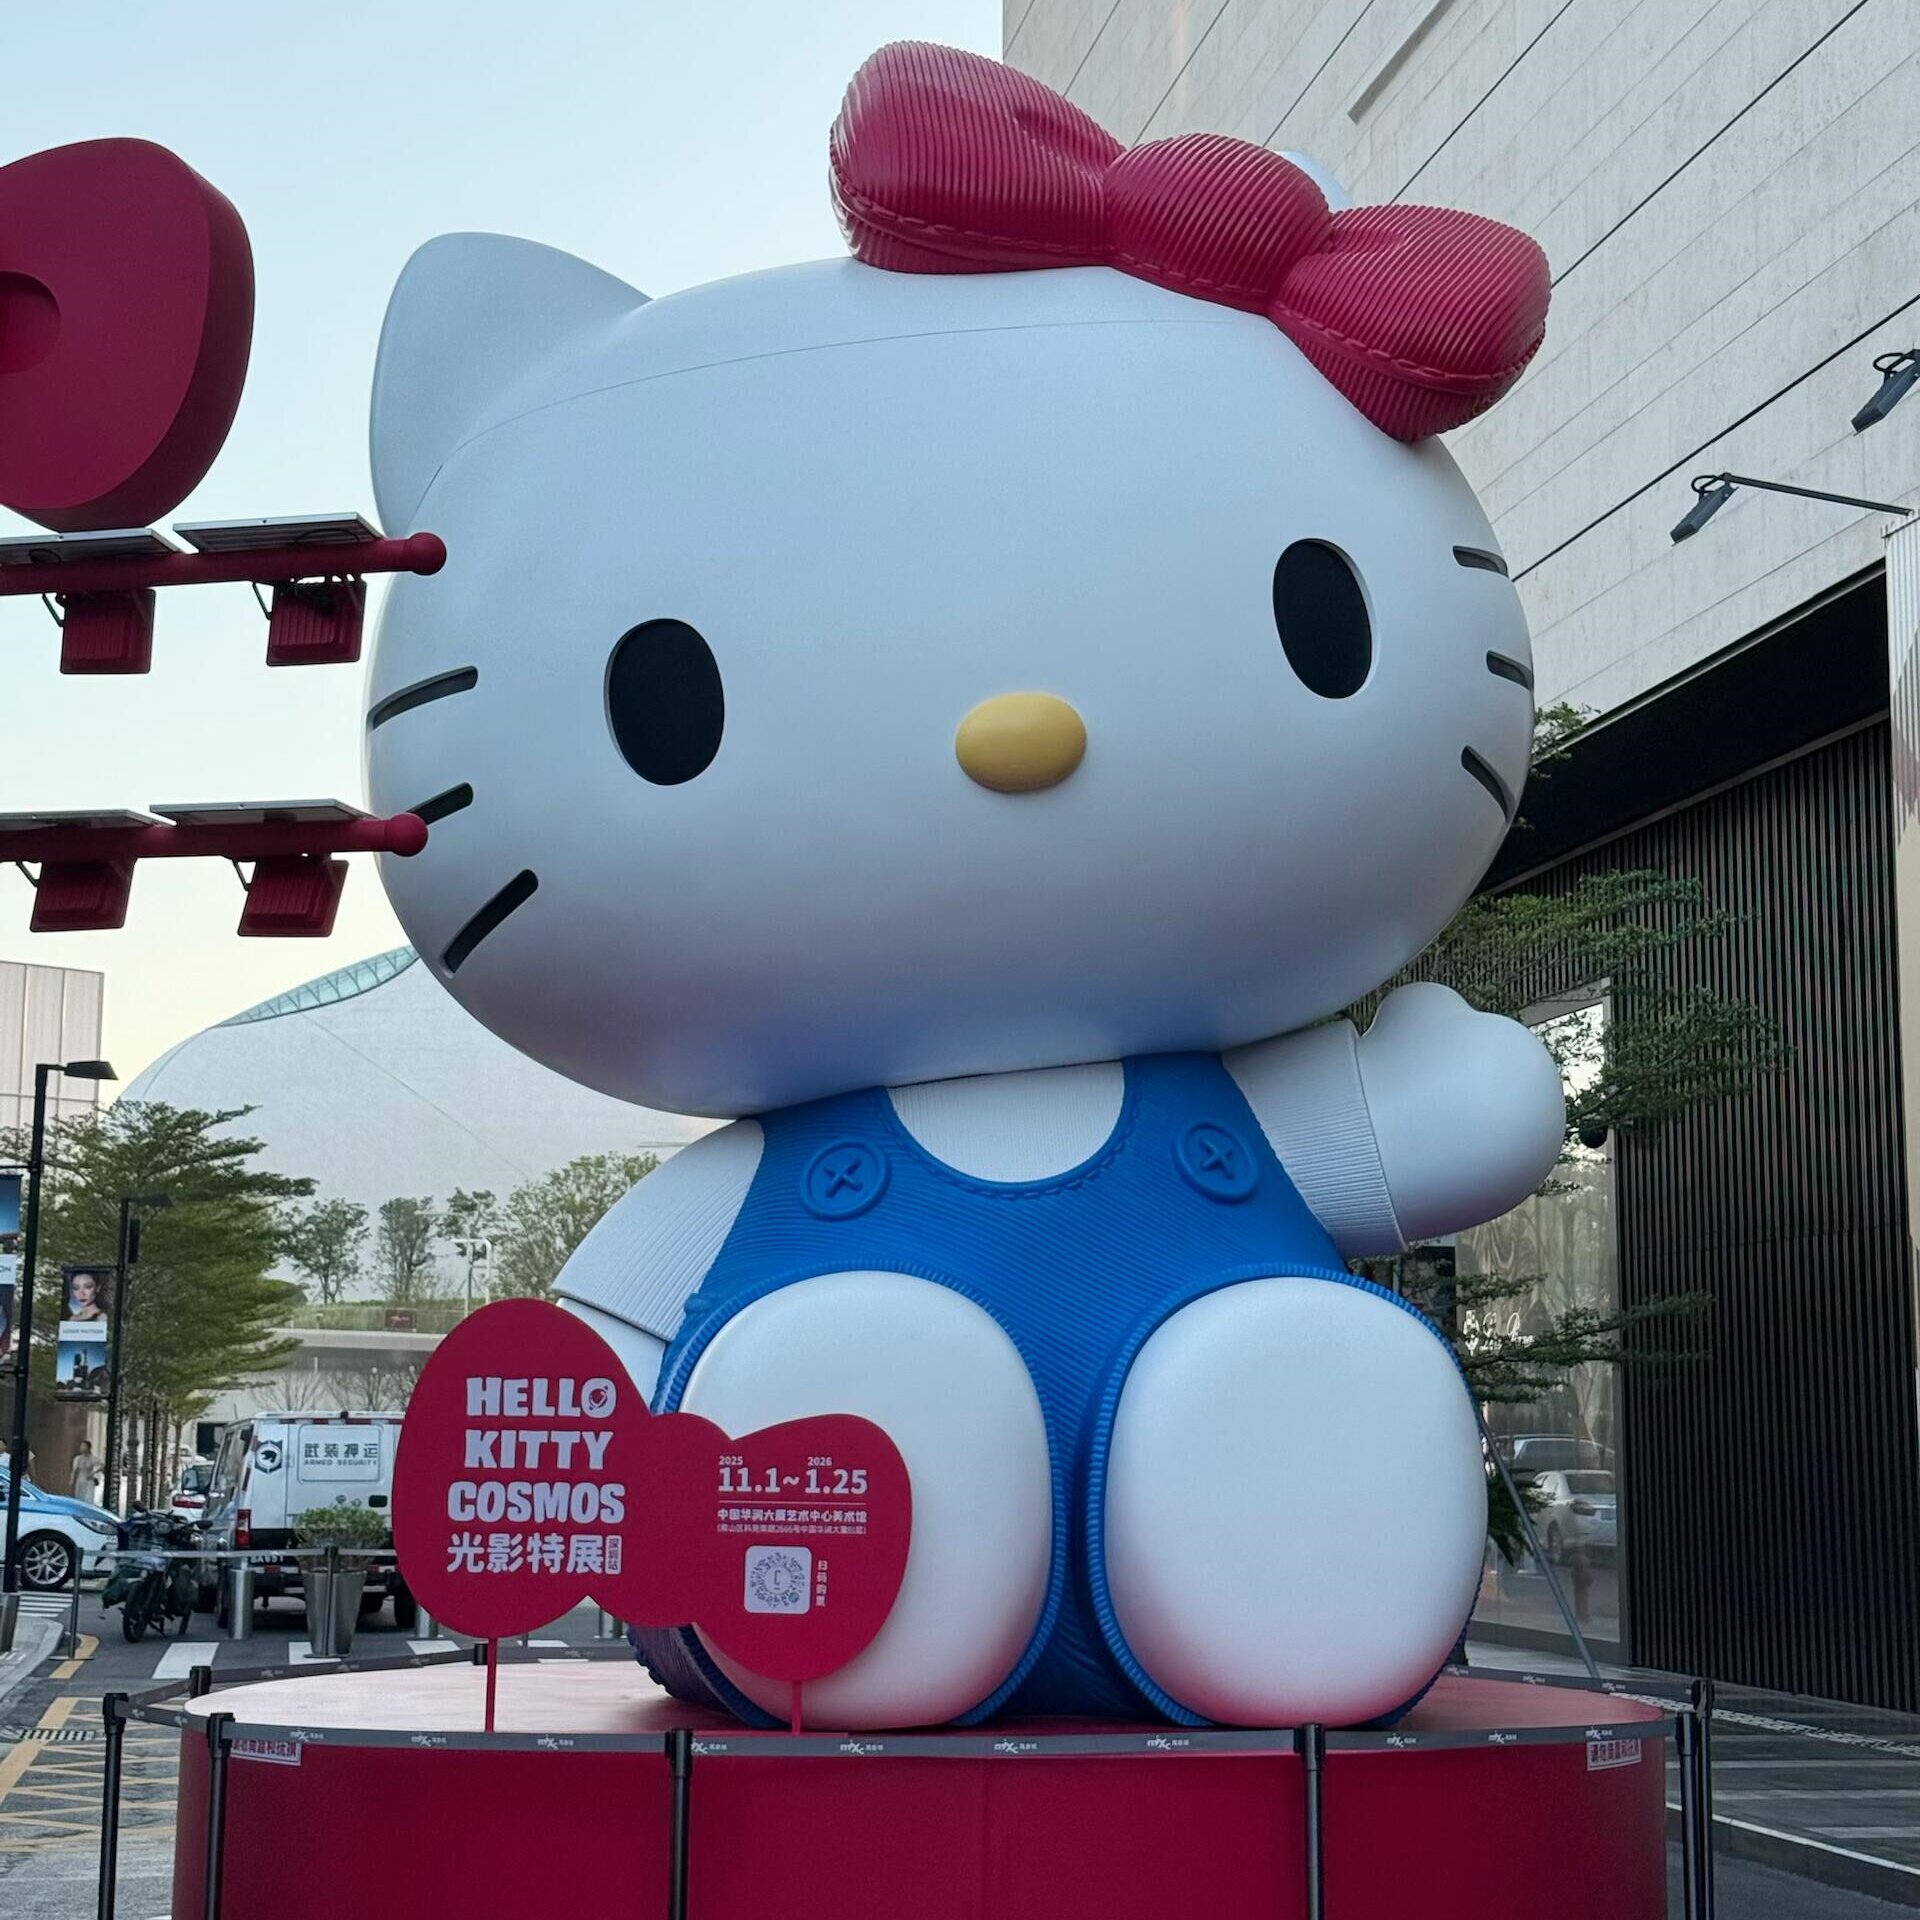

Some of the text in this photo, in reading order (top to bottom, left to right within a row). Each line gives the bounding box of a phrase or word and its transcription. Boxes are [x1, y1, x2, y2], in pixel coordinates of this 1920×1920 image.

[466, 1376, 617, 1418] HELLO
[304, 1443, 378, 1458] 武装押运
[464, 1429, 613, 1470] KITTY
[718, 1456, 832, 1466] 2025 2026
[447, 1480, 625, 1524] COSMOS
[446, 1531, 603, 1573] 光影特展
